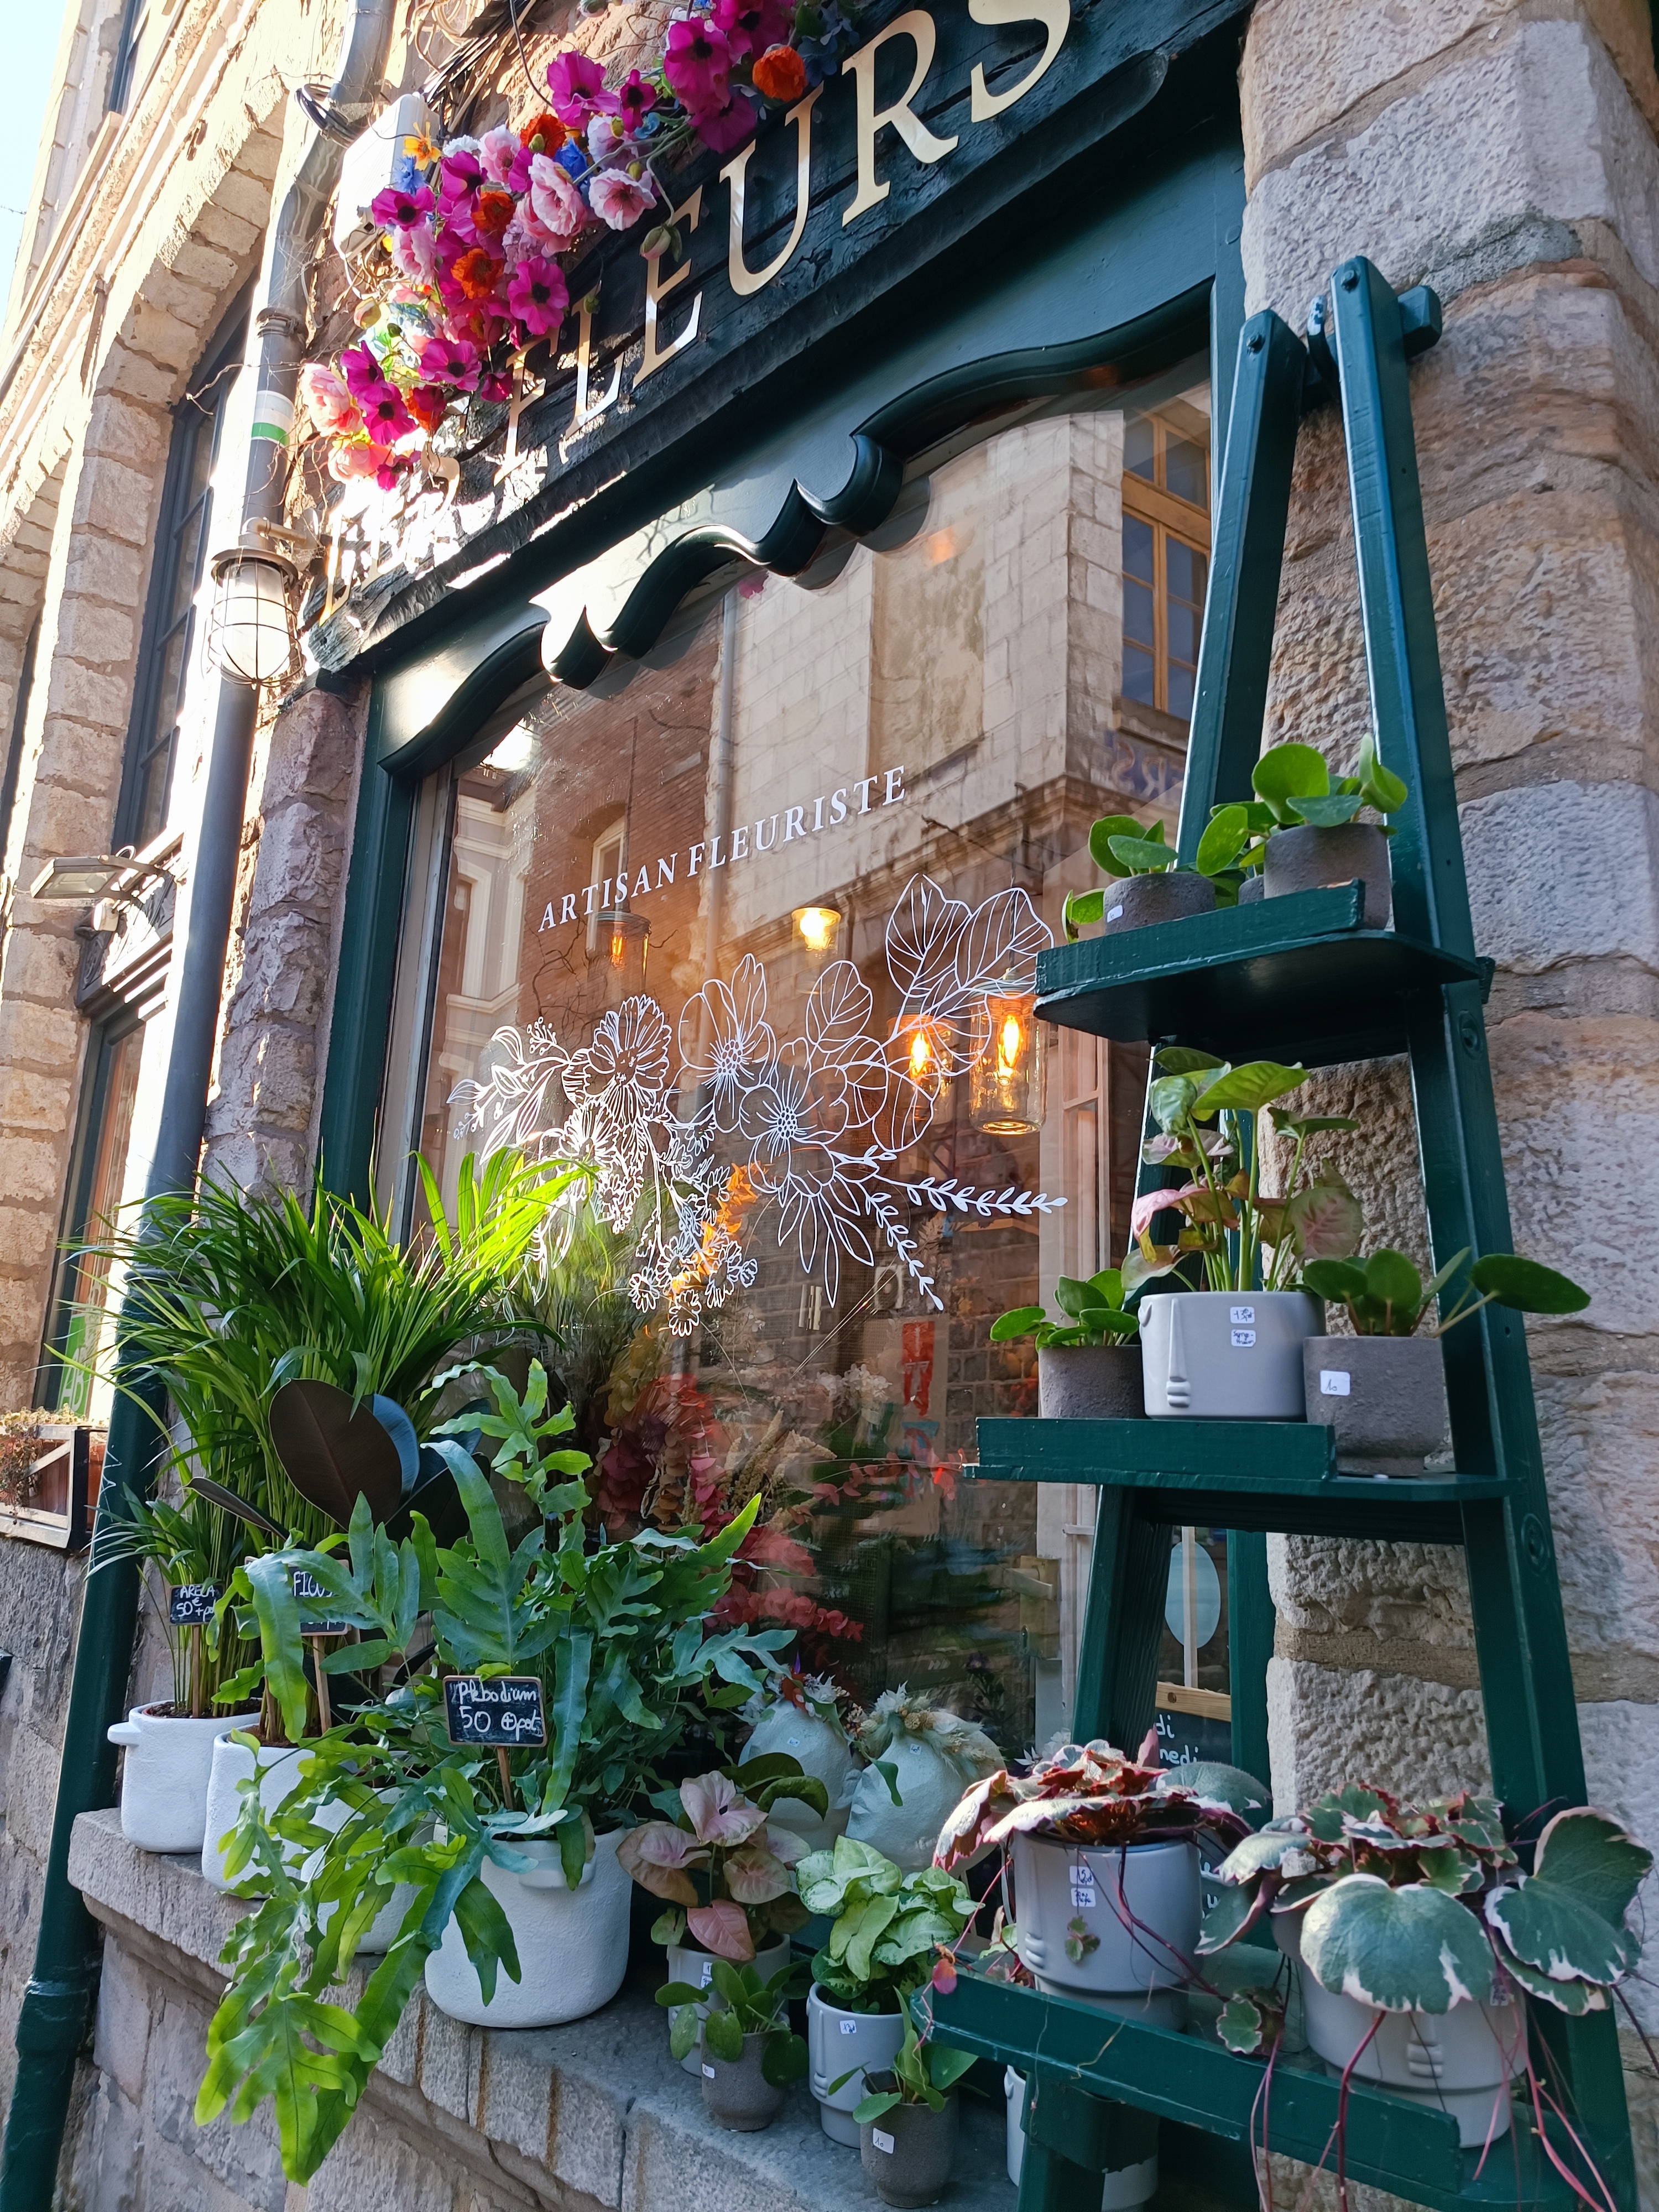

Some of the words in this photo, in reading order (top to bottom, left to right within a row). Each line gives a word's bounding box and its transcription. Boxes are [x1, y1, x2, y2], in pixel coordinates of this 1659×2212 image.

[493, 0, 1072, 486] FLEURS
[538, 852, 678, 933] ARTISAN
[687, 765, 905, 878] FLEURISTE
[458, 1705, 491, 1733] 50
